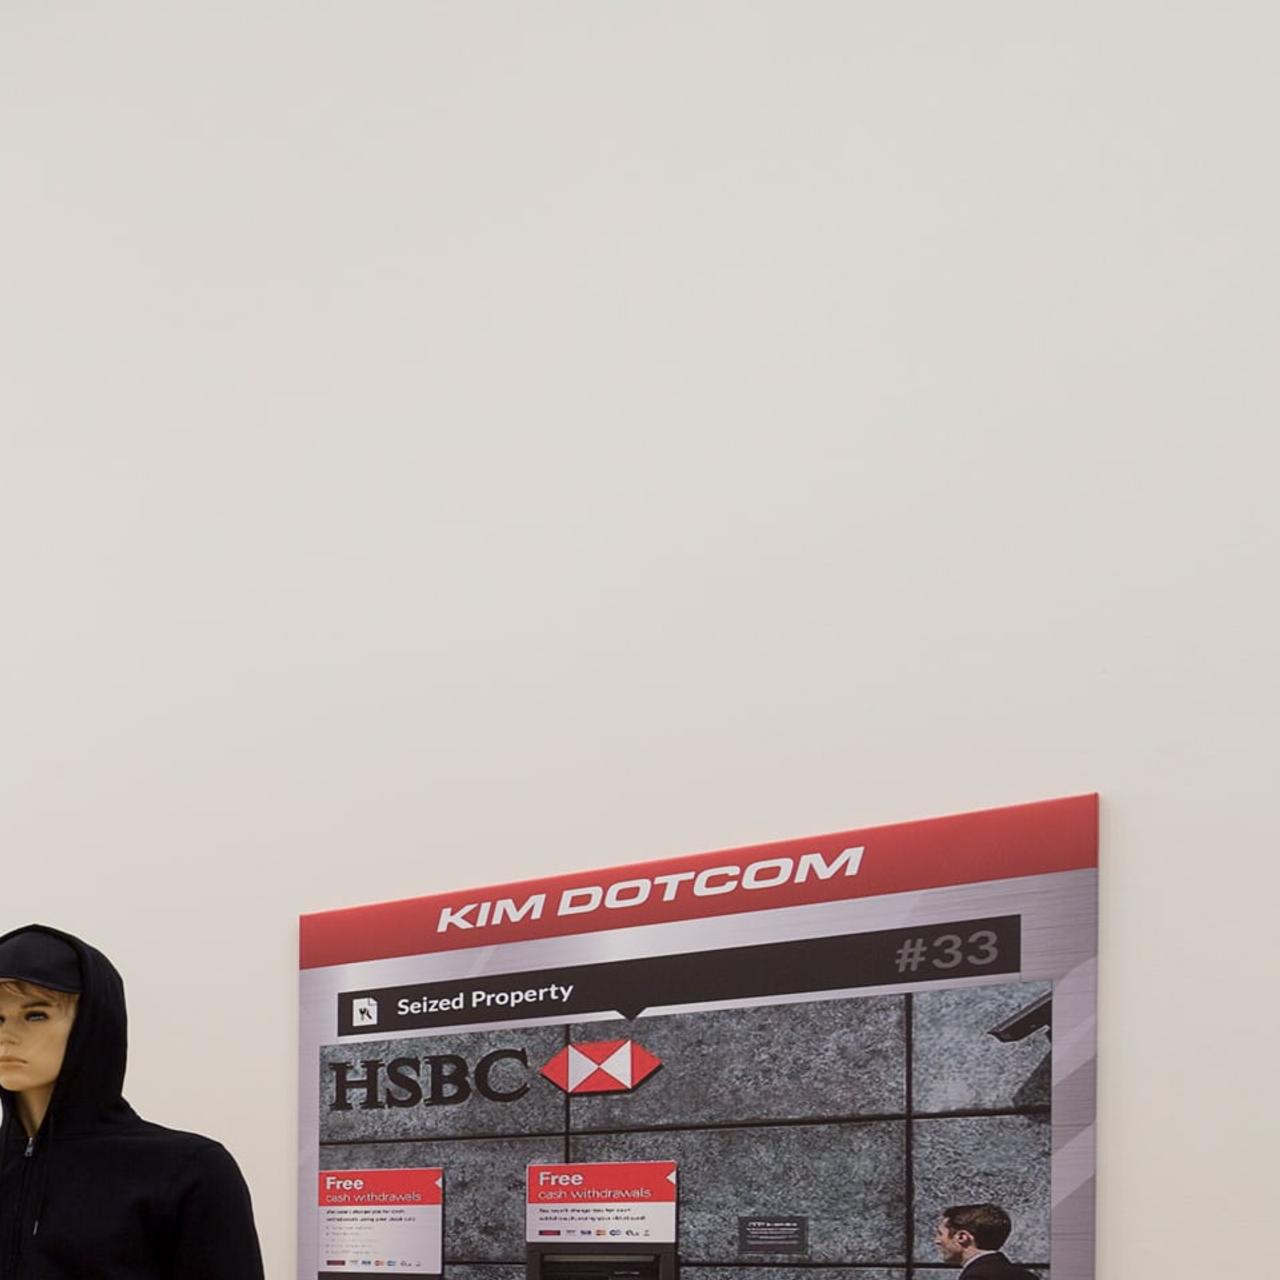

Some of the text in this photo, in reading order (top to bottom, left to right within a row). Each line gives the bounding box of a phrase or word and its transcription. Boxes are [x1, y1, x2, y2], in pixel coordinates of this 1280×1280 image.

[437, 846, 865, 933] KIM DOTCOM
[895, 930, 999, 973] #33
[397, 984, 574, 1016] Seized Property
[328, 1048, 531, 1111] HSBC
[326, 1176, 364, 1190] Free
[539, 1172, 583, 1186] Free
[326, 1191, 422, 1203] cash withdrawals
[538, 1187, 651, 1199] cash withdrawals
